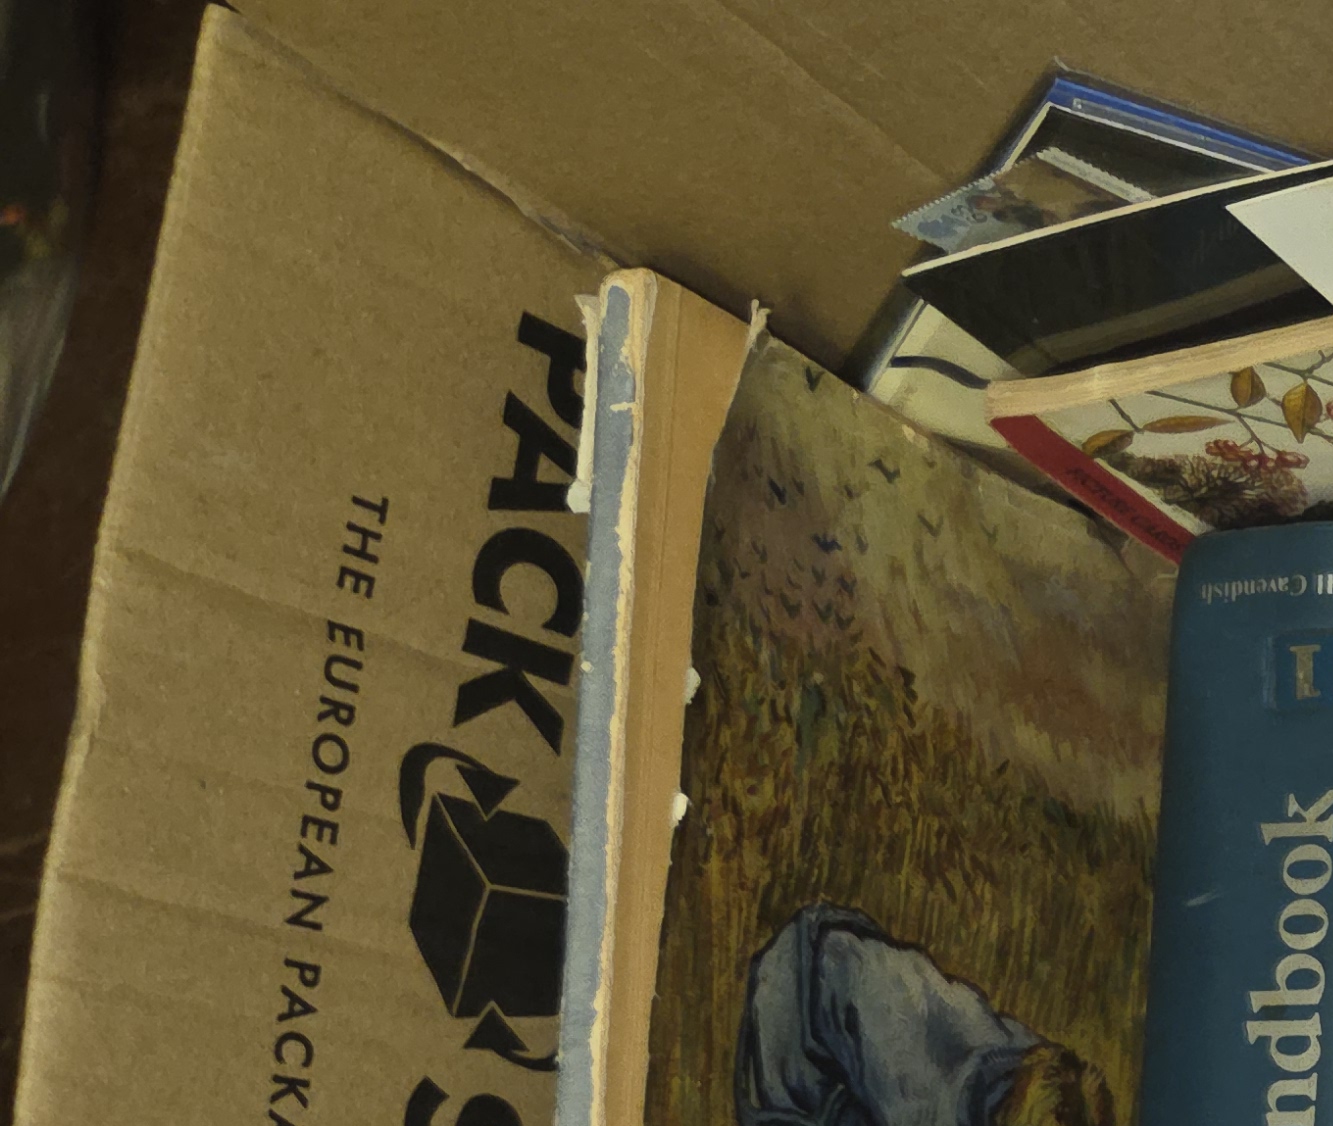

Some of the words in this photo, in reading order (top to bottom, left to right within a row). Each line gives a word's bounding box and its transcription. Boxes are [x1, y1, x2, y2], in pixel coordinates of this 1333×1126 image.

[336, 495, 388, 599] THE
[452, 312, 588, 757] PACK
[1201, 573, 1308, 605] Cavendish
[285, 618, 366, 933] EUROPEAN
